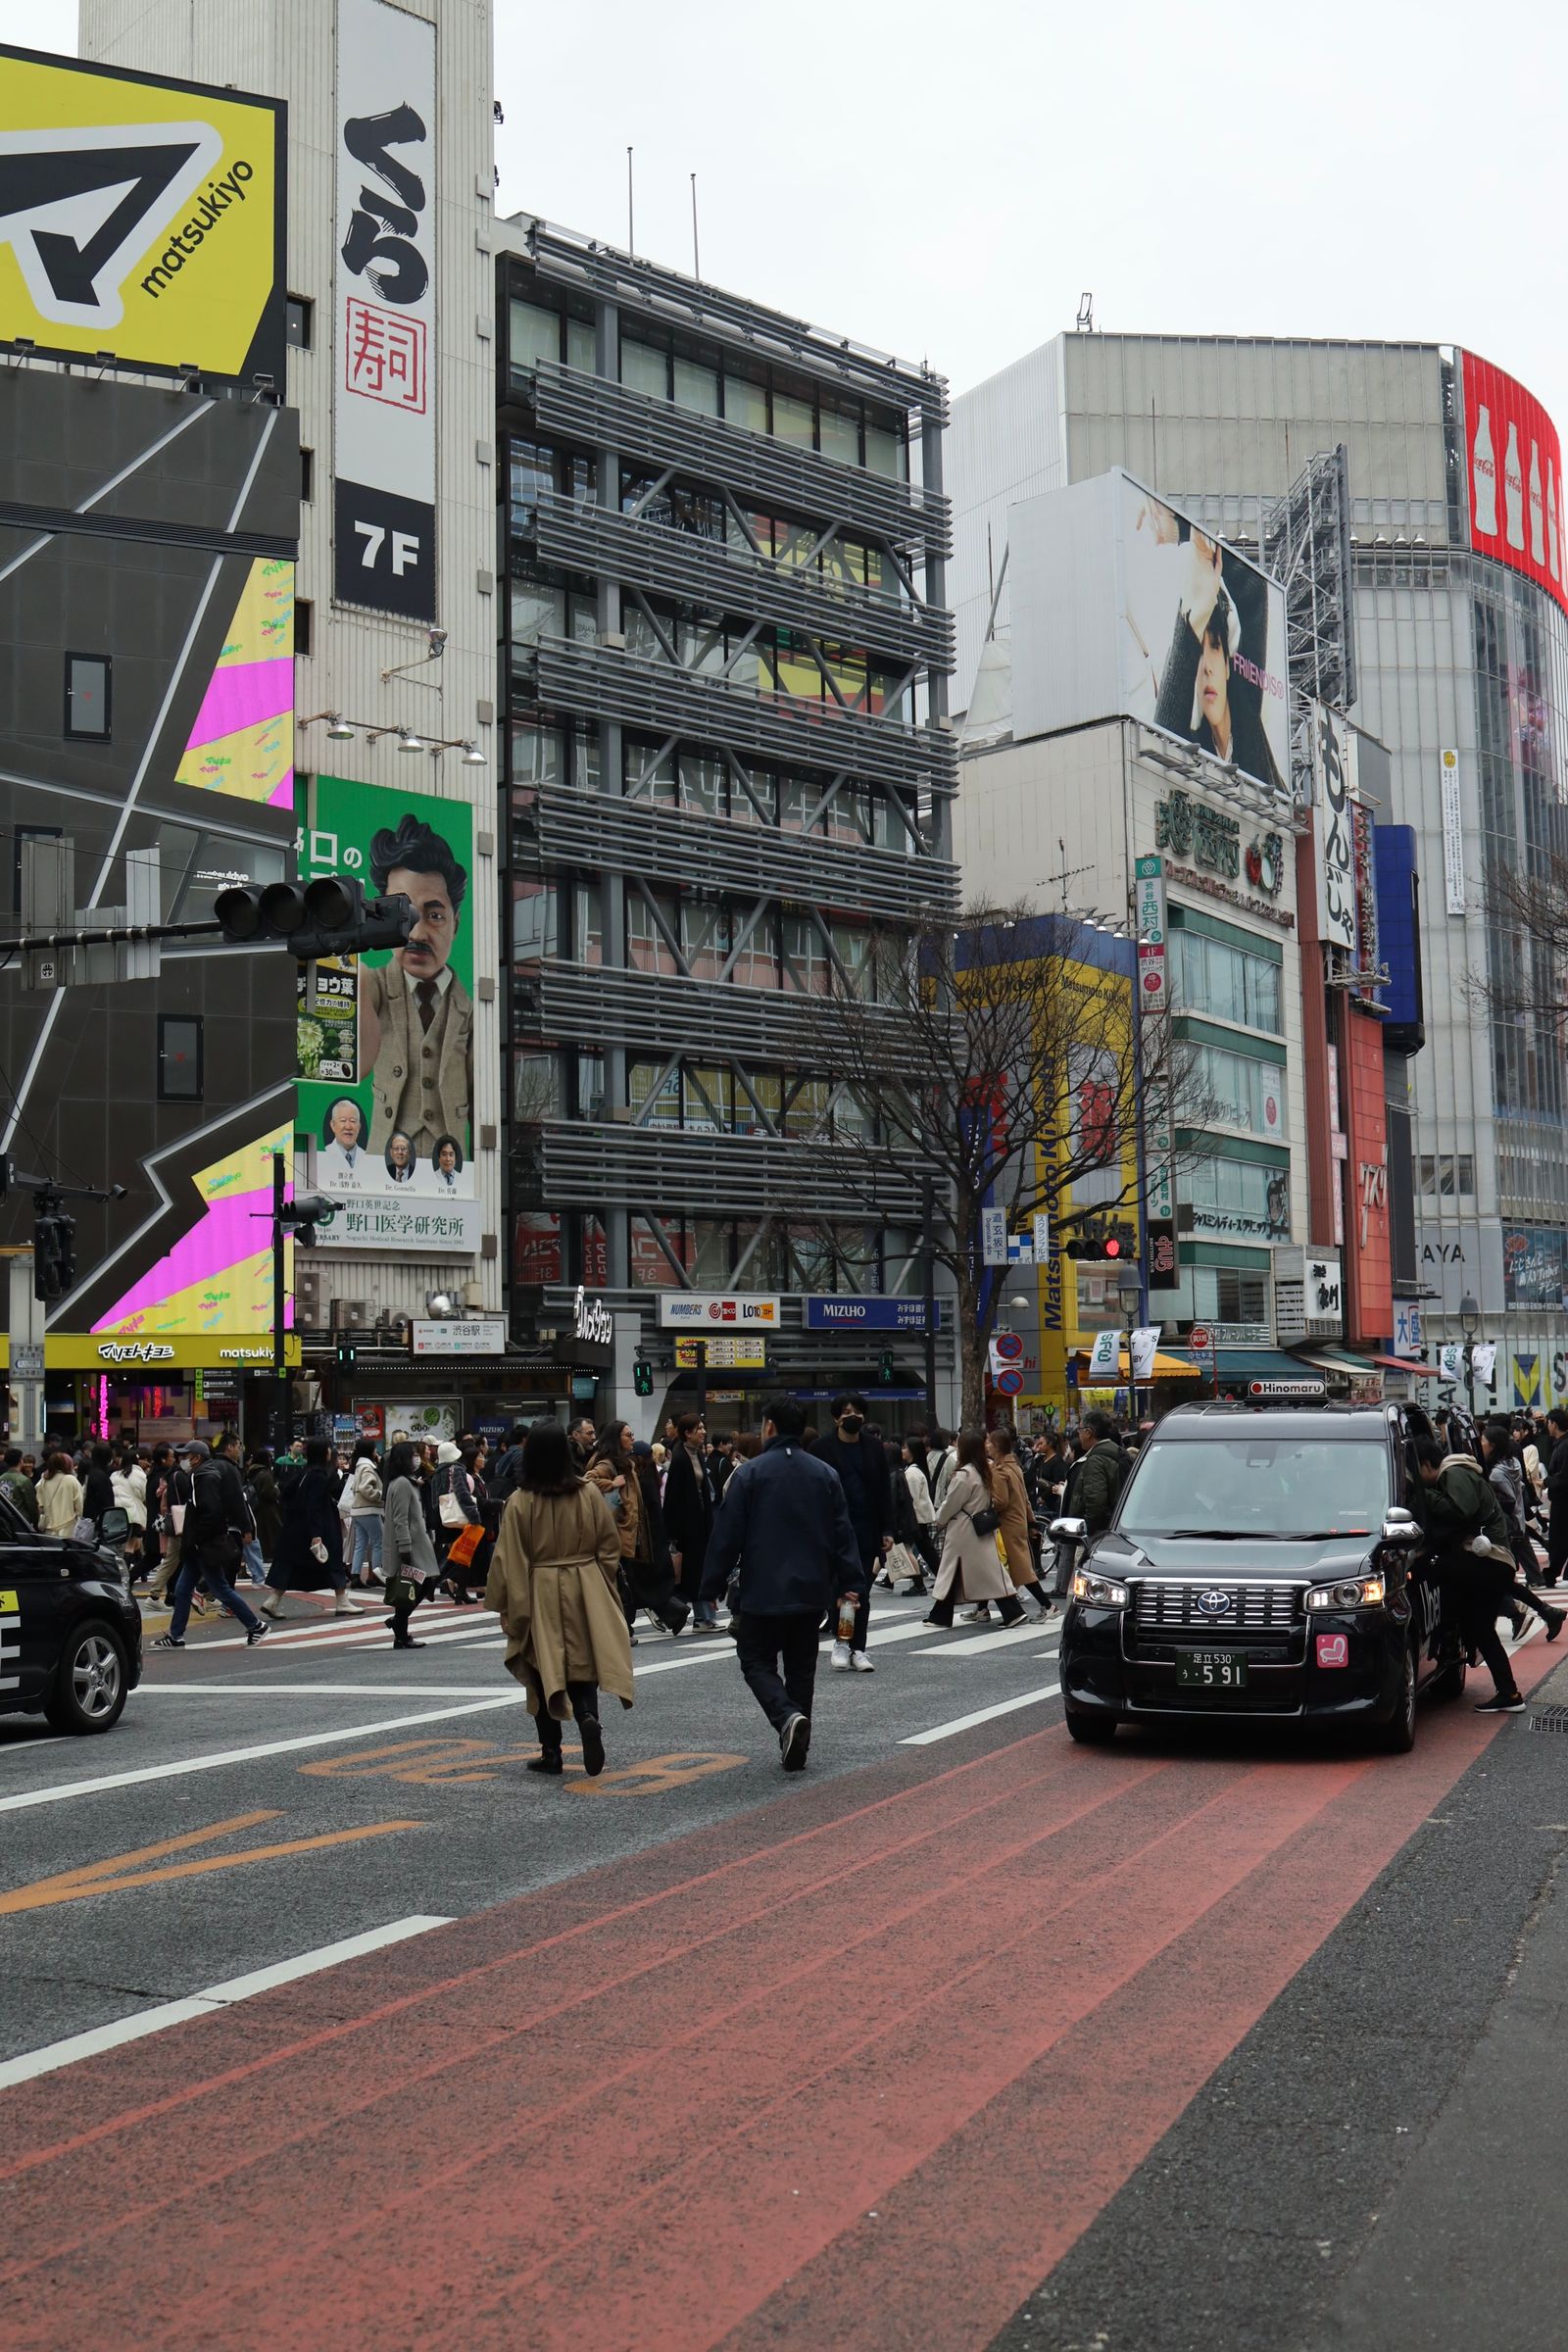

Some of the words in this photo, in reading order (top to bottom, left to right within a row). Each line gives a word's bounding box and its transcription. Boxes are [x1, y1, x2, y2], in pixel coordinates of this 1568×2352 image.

[140, 160, 254, 299] matsukiyo
[353, 309, 419, 403] 寿司
[354, 519, 419, 576] 7F
[346, 1199, 401, 1211] 野口英世記念
[346, 1212, 465, 1237] 野口医学研究所
[993, 1212, 1004, 1260] 道玄坂下
[1037, 1216, 1046, 1261] スクランブル式
[1154, 1235, 1174, 1272] HUB
[1416, 1244, 1466, 1262] AYA
[670, 1303, 703, 1316] NUMBERS
[823, 1304, 866, 1317] MIZUHO
[453, 1324, 481, 1336] 渋谷駅
[98, 1343, 174, 1361] マツモトキヨシ
[220, 1347, 274, 1360] matsukiy
[1262, 1382, 1322, 1395] Hinomaru
[1193, 1653, 1212, 1664] 足立
[1213, 1653, 1232, 1664] 530
